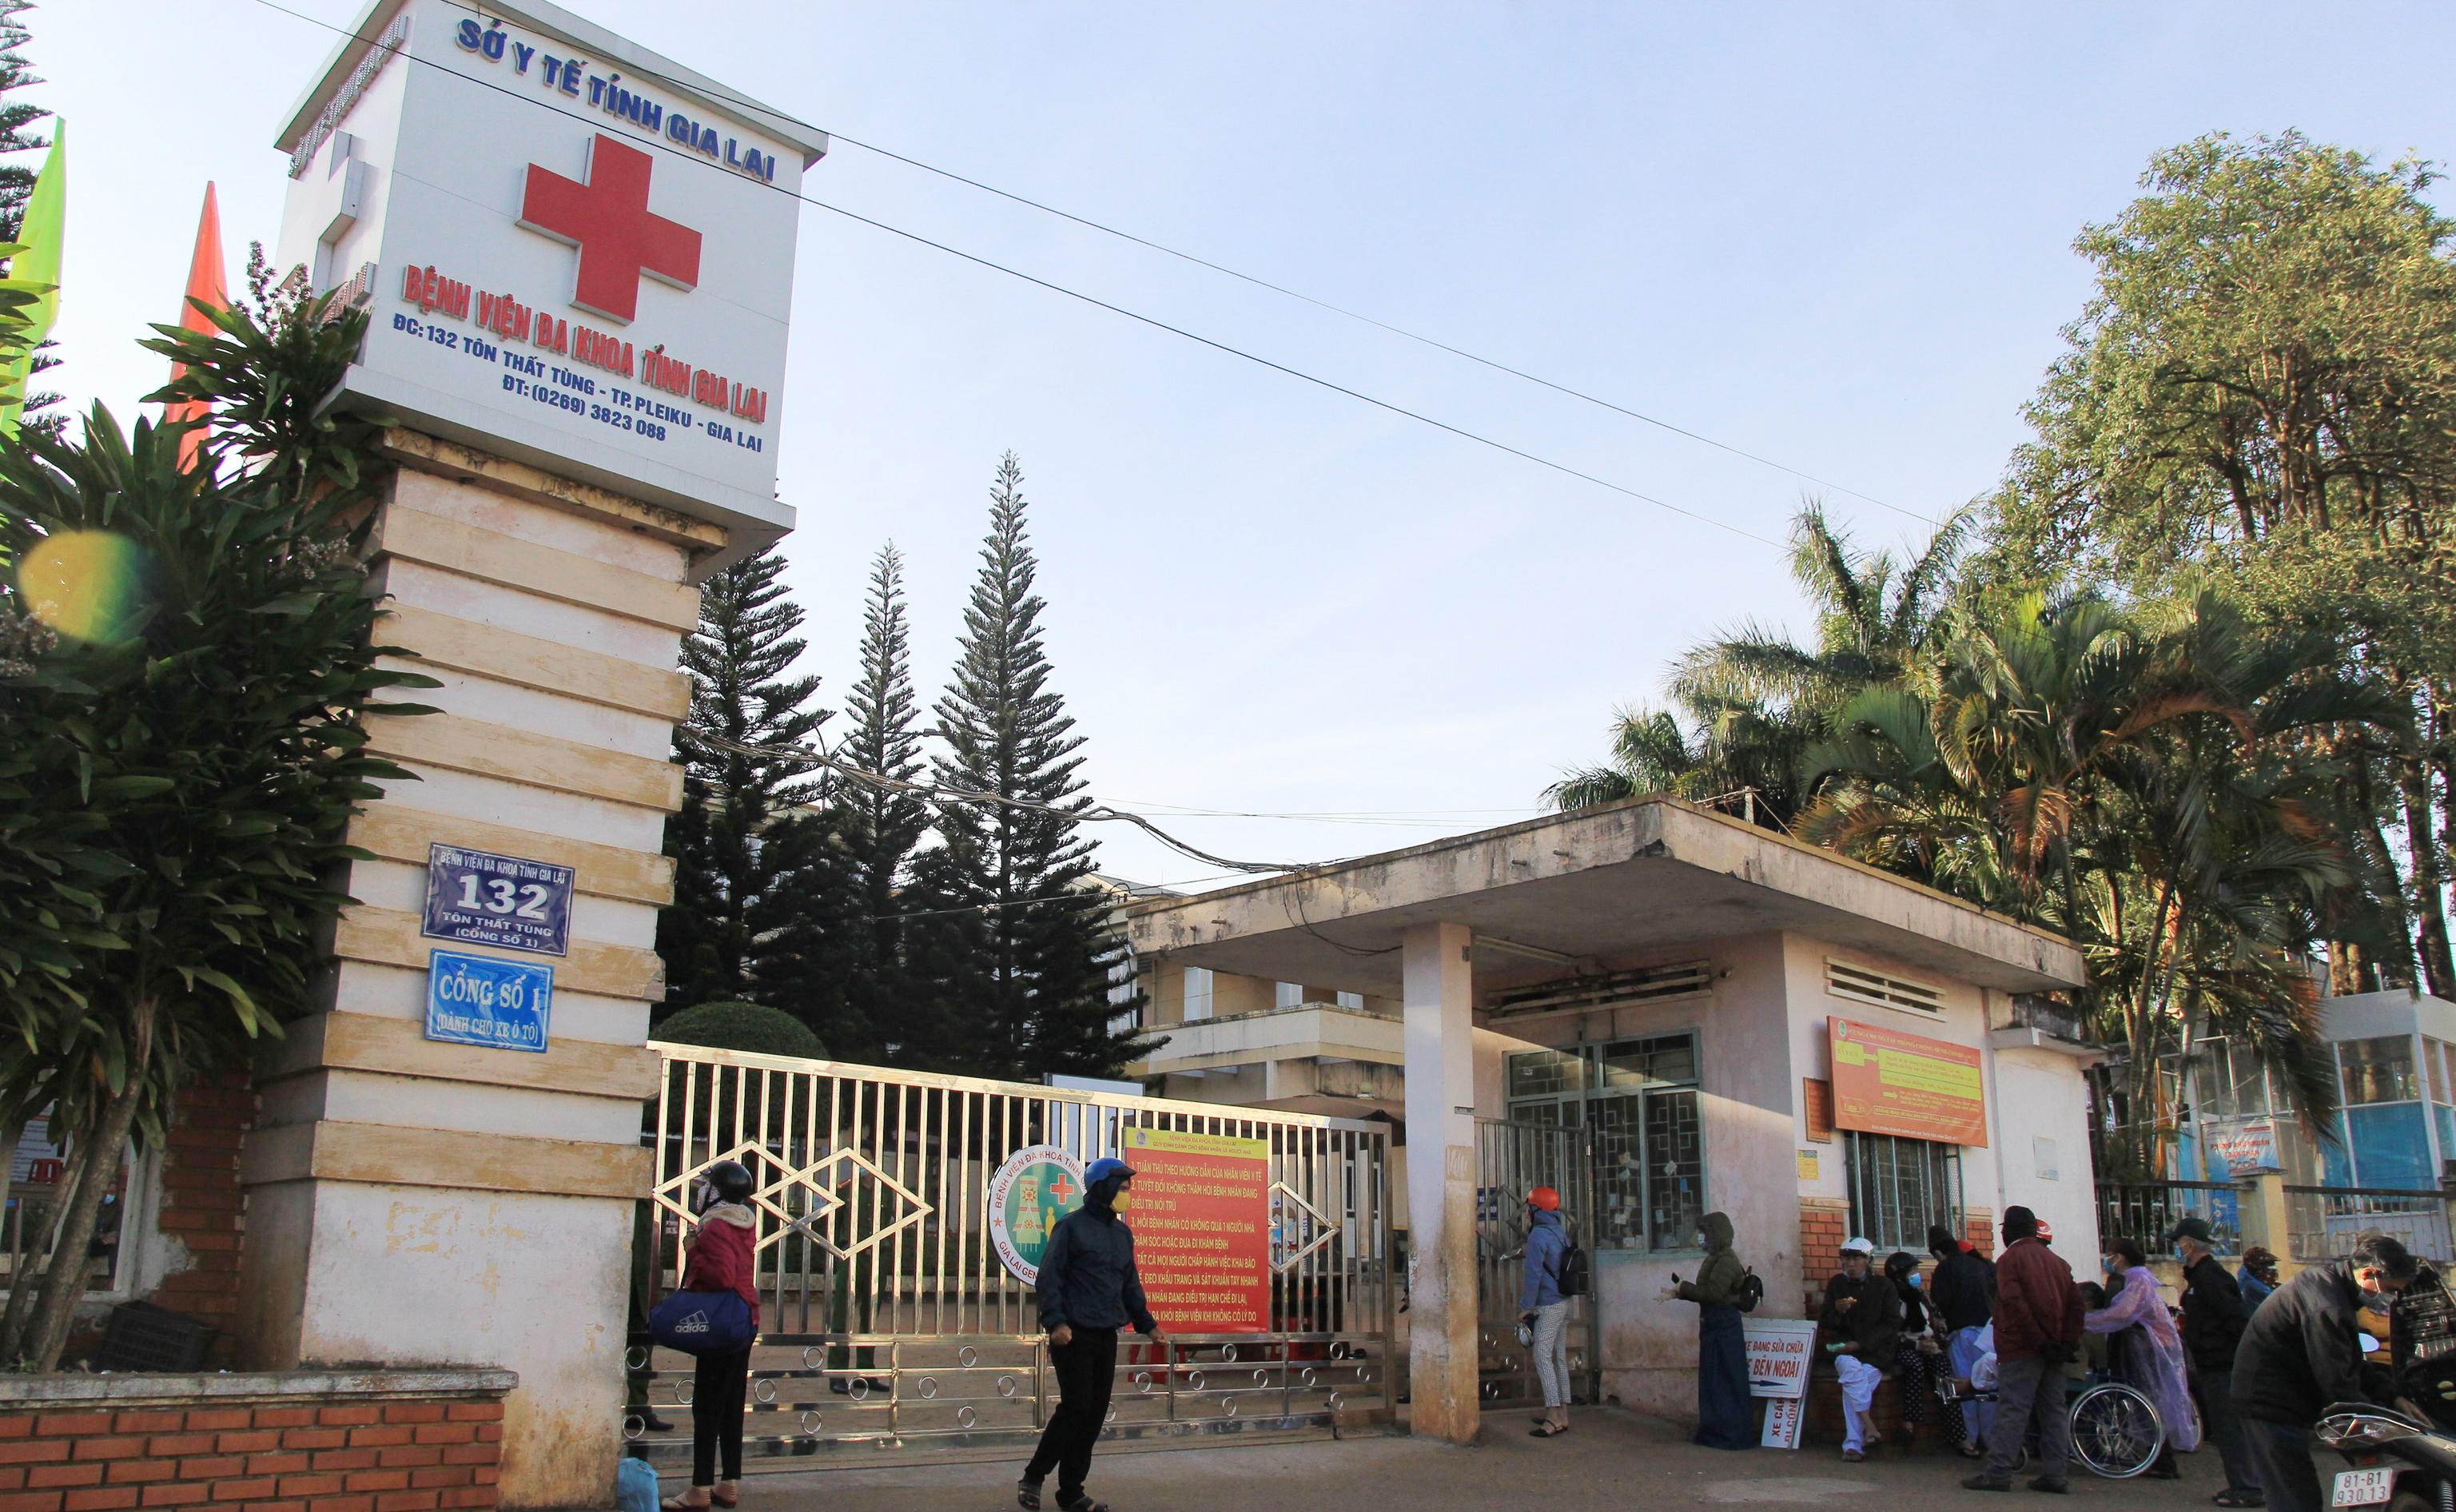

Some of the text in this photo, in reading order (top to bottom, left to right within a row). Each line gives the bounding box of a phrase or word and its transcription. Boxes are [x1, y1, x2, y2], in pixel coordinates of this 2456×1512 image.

[456, 18, 775, 184] SỞ Y TẾ TỈNH GIA LAI
[402, 264, 471, 321] BỆNH
[476, 290, 532, 342] VIỆN
[534, 312, 567, 356] ĐA
[571, 325, 634, 379] KHOA
[641, 344, 691, 397] TỈNH
[692, 369, 728, 411] GIA
[730, 382, 767, 424] LAI
[463, 336, 497, 363] TÔN
[503, 351, 546, 379] THẤT
[551, 367, 595, 396] TÙNG
[707, 421, 733, 443] GIA
[737, 432, 762, 452] LAI
[591, 404, 632, 431] 3823
[635, 420, 667, 441] 088
[440, 850, 565, 884] BỆNH VIỆN ĐA KHOA TỈNH GIA LAI
[457, 874, 548, 920] 132
[443, 912, 552, 937] TÔN THẤT TÙNG
[456, 926, 538, 948] (CỔNG SỐ 1)
[440, 962, 540, 1012] CỔNG SỐ 1
[437, 1011, 539, 1043] (DÀNH CHO XE Ô TÔ)
[995, 1150, 1081, 1208] BỆNH VIỆN ĐA KHOA TỈNH
[1136, 1160, 1262, 1181] TUÂN THỦ THEO HƯỚNG DẪN CỦA NHÂN VIÊN Y TẾ
[1137, 1178, 1154, 1194] TUYỆT
[1155, 1178, 1165, 1192] ĐỐI
[1167, 1180, 1186, 1193] KHÔNG
[1203, 1182, 1212, 1196] HỎI
[1213, 1184, 1227, 1199] BỆNH
[1228, 1184, 1242, 1197] NHÂN
[1243, 1188, 1258, 1199] ĐANG
[1145, 1199, 1154, 1212] TRỊ
[1154, 1197, 1164, 1213] NỘI
[1166, 1199, 1176, 1212] TRÚ
[1149, 1216, 1164, 1231] BỆNH
[1164, 1216, 1180, 1229] NHÂN
[1180, 1217, 1189, 1230] CÓ
[1190, 1218, 1209, 1231] KHÔNG
[1227, 1220, 1244, 1232] NGƯỜI
[1244, 1221, 1255, 1232] NHÀ
[1148, 1233, 1160, 1247] SÓC
[1162, 1235, 1178, 1250] HOẶC
[1179, 1237, 1191, 1247] ĐƯA
[1192, 1238, 1197, 1248] ĐI
[1199, 1236, 1214, 1249] KHÁM
[1215, 1236, 1228, 1252] BỆNH
[999, 1241, 1011, 1259] GIA
[1009, 1256, 1021, 1271] LAI
[1137, 1251, 1256, 1270] TẤT CẢ MỌI NGƯỜI CHẤP HÀNH VIỆC KHAI BÁO
[1144, 1273, 1156, 1283] ĐEO
[1174, 1274, 1192, 1285] TRANG
[1193, 1272, 1200, 1285] VÀ
[1201, 1272, 1211, 1285] SÁT
[1231, 1275, 1240, 1285] TAY
[1240, 1276, 1258, 1286] NHANH
[1152, 1289, 1167, 1303] NHÂN
[1168, 1292, 1184, 1303] ĐANG
[1208, 1293, 1219, 1306] HẠN
[1220, 1290, 1230, 1303] CHẾ
[1232, 1293, 1237, 1303] ĐI
[1160, 1307, 1174, 1321] KHỎI
[1175, 1308, 1189, 1323] BỆNH
[1190, 1308, 1201, 1324] VIỆN
[1203, 1311, 1212, 1322] KHI
[1212, 1308, 1231, 1322] KHÔNG
[1232, 1308, 1240, 1322] CÓ
[1241, 1309, 1248, 1322] LÝ
[1248, 1311, 1256, 1322] DO
[1753, 1338, 1803, 1353] ĐANG SỬA CHỮA
[1753, 1355, 1772, 1376] BÊN
[1773, 1356, 1800, 1378] NGOÀI
[1772, 1422, 1781, 1437] XE
[2344, 1471, 2382, 1488] 81-B1
[2337, 1486, 2386, 1504] 930.13
